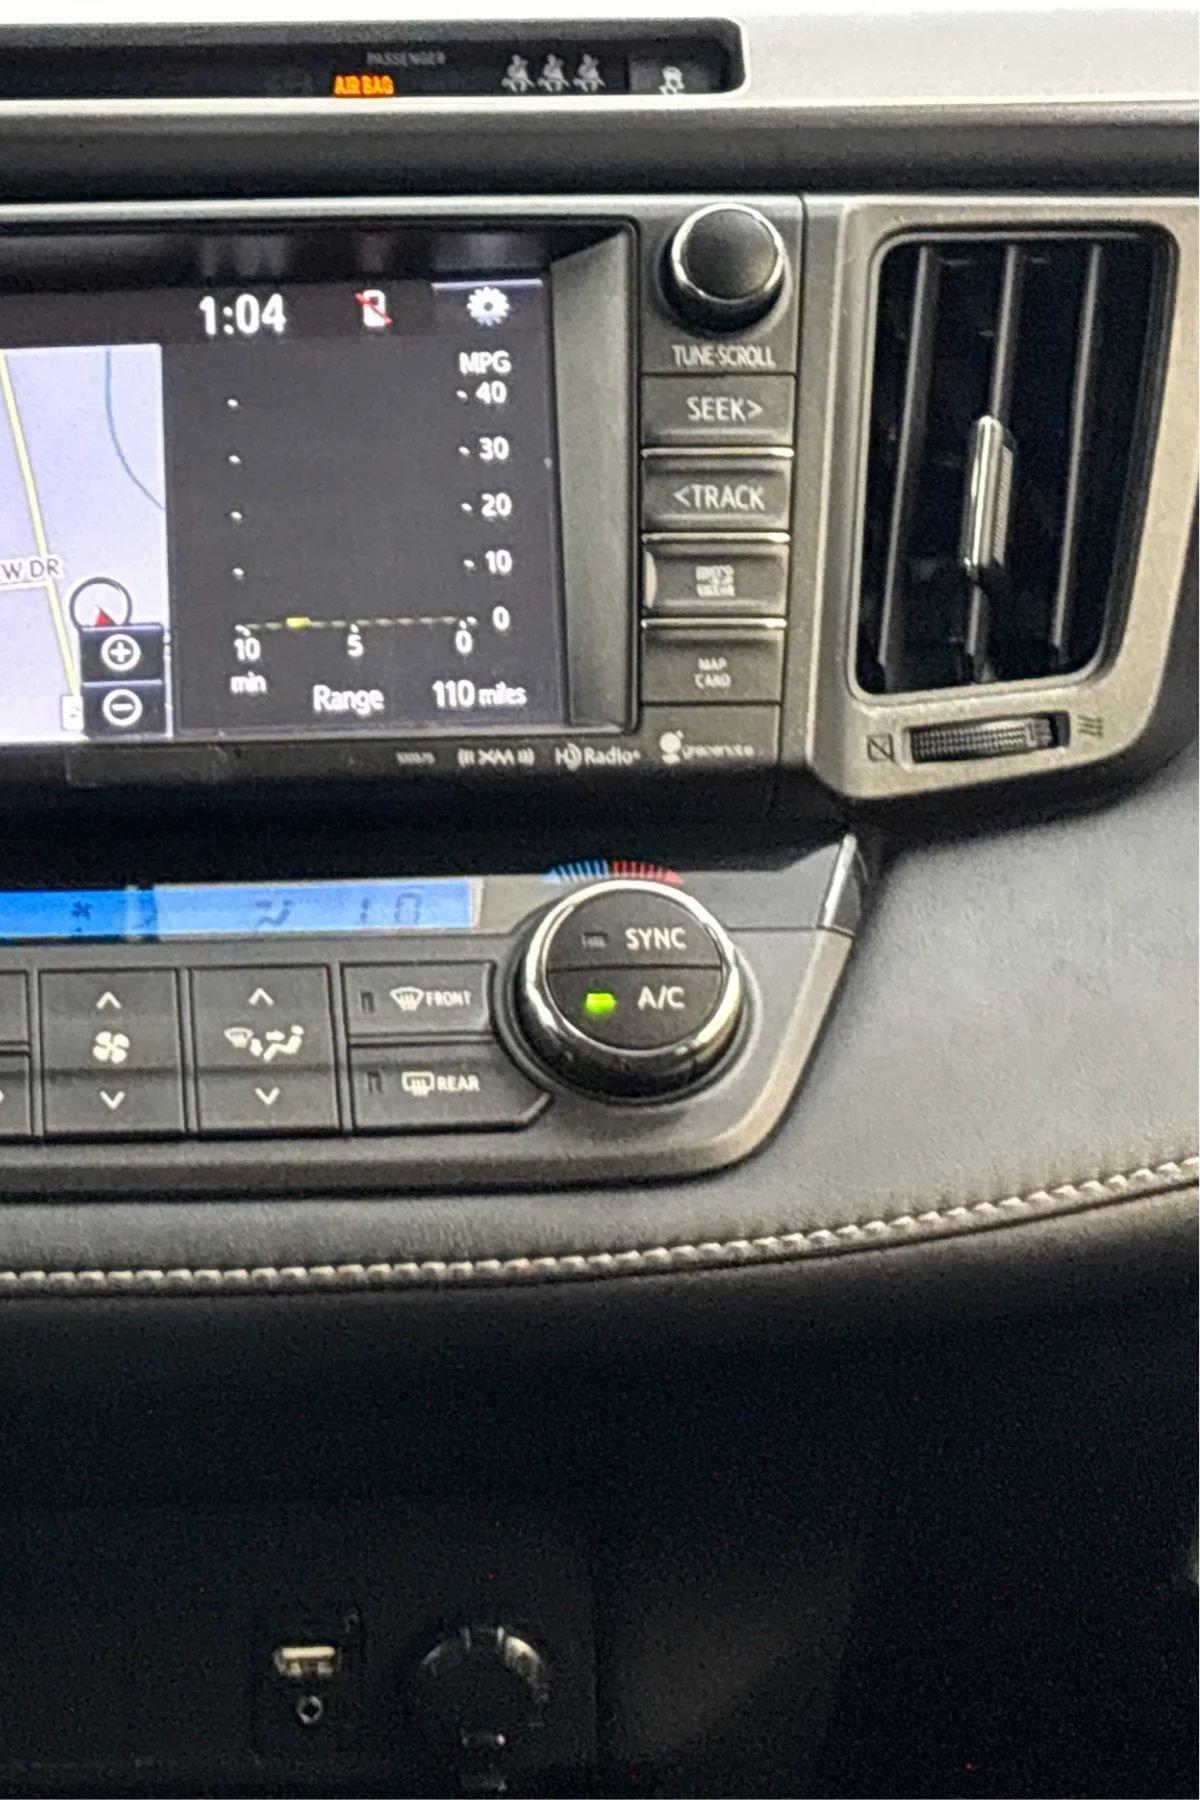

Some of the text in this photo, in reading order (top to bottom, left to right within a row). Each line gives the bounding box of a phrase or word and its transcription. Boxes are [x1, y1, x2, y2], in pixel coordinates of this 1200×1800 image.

[361, 74, 394, 95] BAG
[199, 293, 287, 336] 1:04
[459, 350, 512, 375] MPG
[475, 380, 508, 405] 40
[478, 436, 510, 461] 30
[481, 492, 513, 517] 20
[30, 557, 61, 578] DR
[485, 549, 513, 575] 10
[492, 606, 511, 631] 0
[233, 629, 474, 662] 10 5 0
[698, 657, 727, 671] MAP
[230, 671, 268, 695] min
[312, 679, 528, 715] Range 110 miles
[625, 927, 687, 950] SYNC
[426, 991, 472, 1006] FRONT
[637, 986, 685, 1009] A/C
[437, 1075, 480, 1091] REAR
